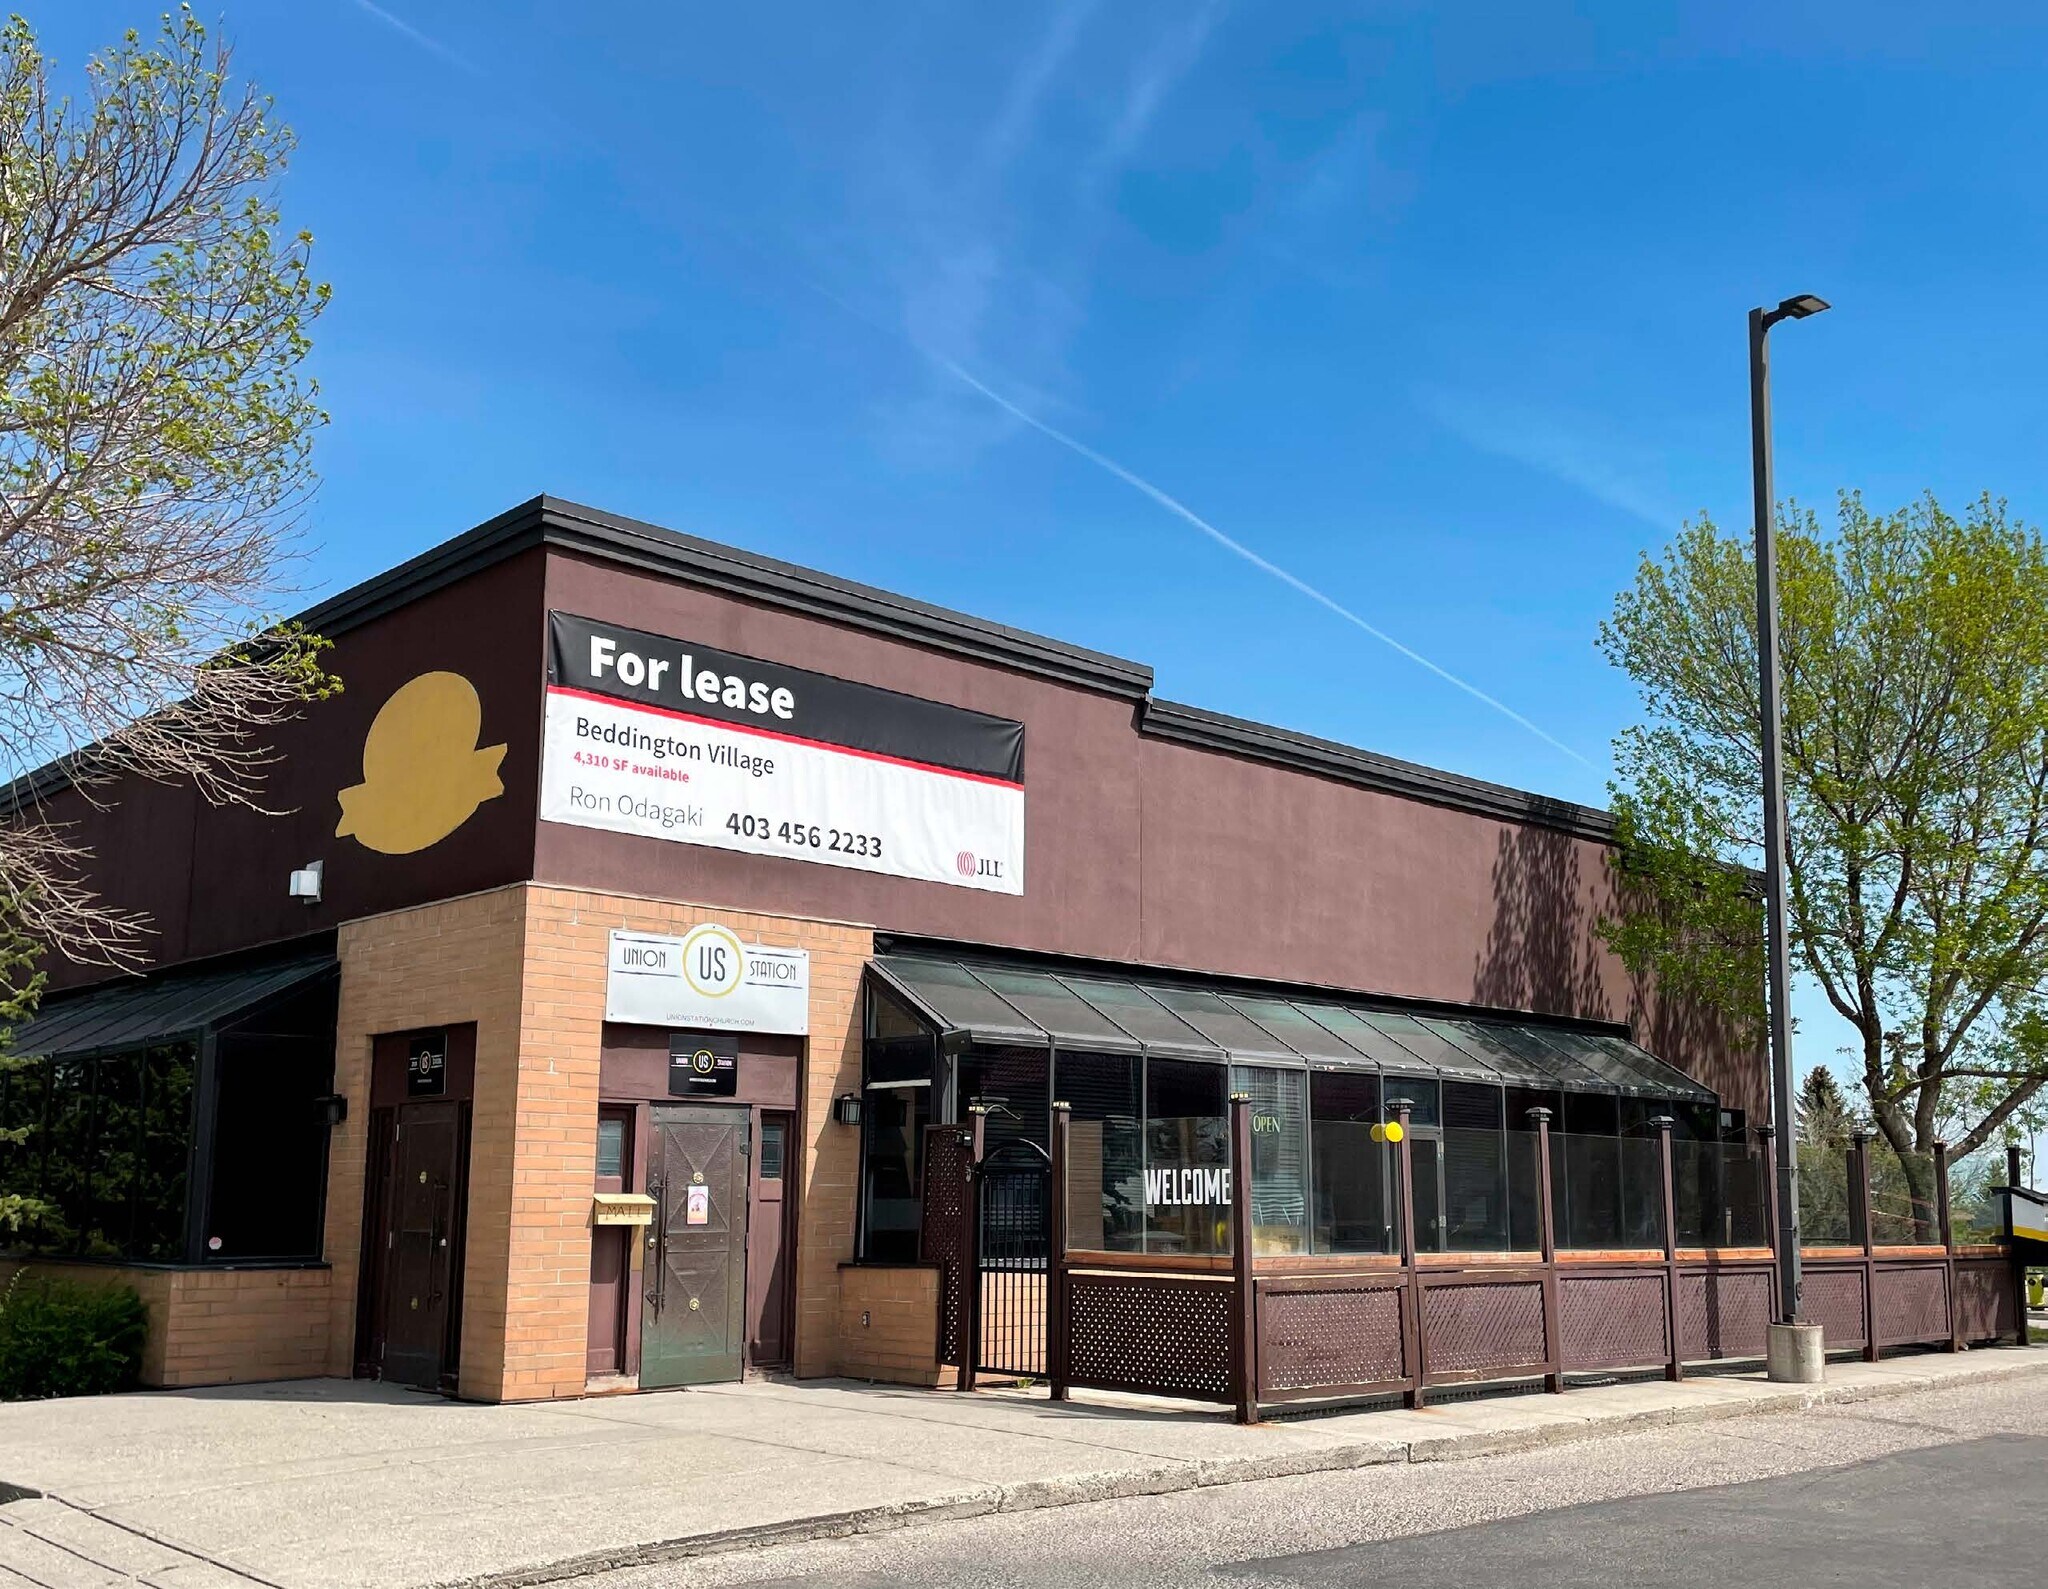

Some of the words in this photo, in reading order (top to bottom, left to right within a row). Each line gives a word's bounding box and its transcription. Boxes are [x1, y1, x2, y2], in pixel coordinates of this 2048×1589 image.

[590, 635, 670, 691] For
[681, 653, 795, 720] lease
[576, 716, 701, 759] Beddington
[707, 743, 774, 778] Village
[573, 751, 609, 768] 4,310
[613, 759, 629, 772] SF
[631, 763, 690, 783] available
[570, 785, 611, 812] Ron
[617, 794, 703, 829] Odagaki
[725, 812, 770, 840] 403
[777, 821, 821, 848] 456
[828, 829, 882, 858] 2233
[977, 858, 1002, 878] JLL
[623, 947, 667, 969] UNION
[699, 946, 726, 982] US
[749, 960, 797, 981] STATION
[698, 1054, 709, 1068] US
[1253, 1115, 1280, 1133] OPEN
[1144, 1168, 1232, 1205] WELCOME
